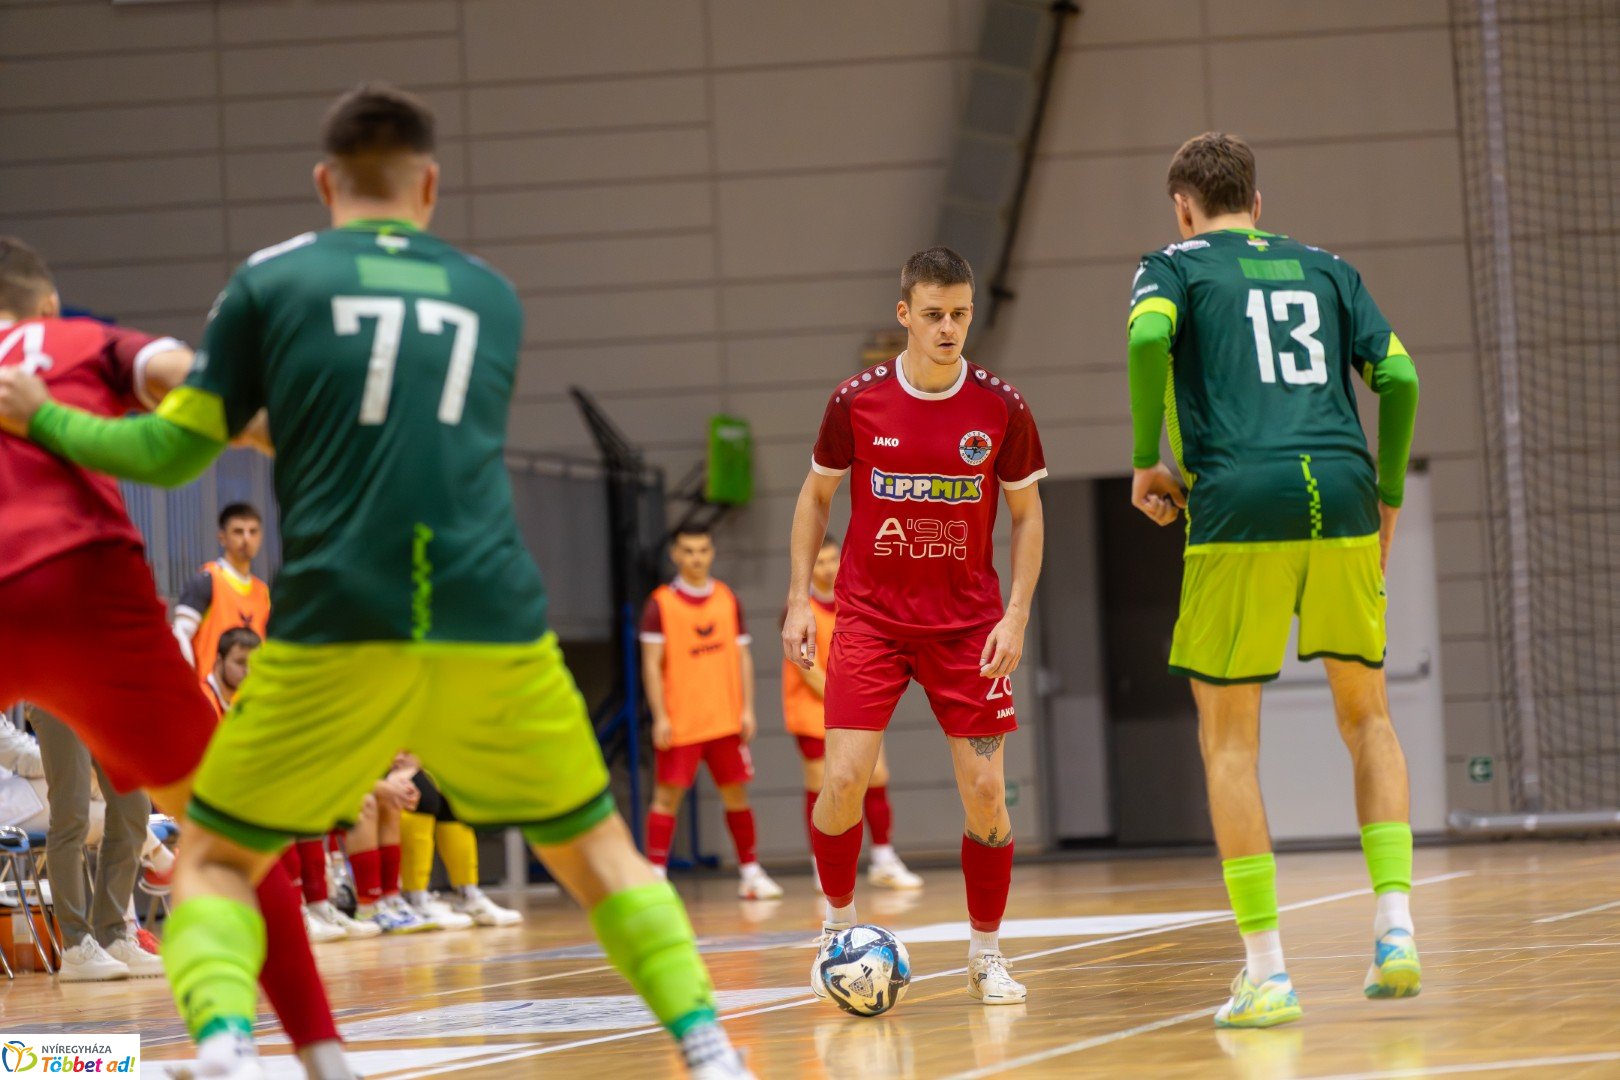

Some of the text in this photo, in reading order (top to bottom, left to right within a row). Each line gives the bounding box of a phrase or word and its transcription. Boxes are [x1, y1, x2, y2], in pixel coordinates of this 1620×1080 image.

[1246, 288, 1328, 385] 13
[331, 295, 479, 425] 77
[873, 436, 899, 447] JAKO
[874, 541, 967, 560] STUDIO
[996, 706, 1015, 719] JAKO
